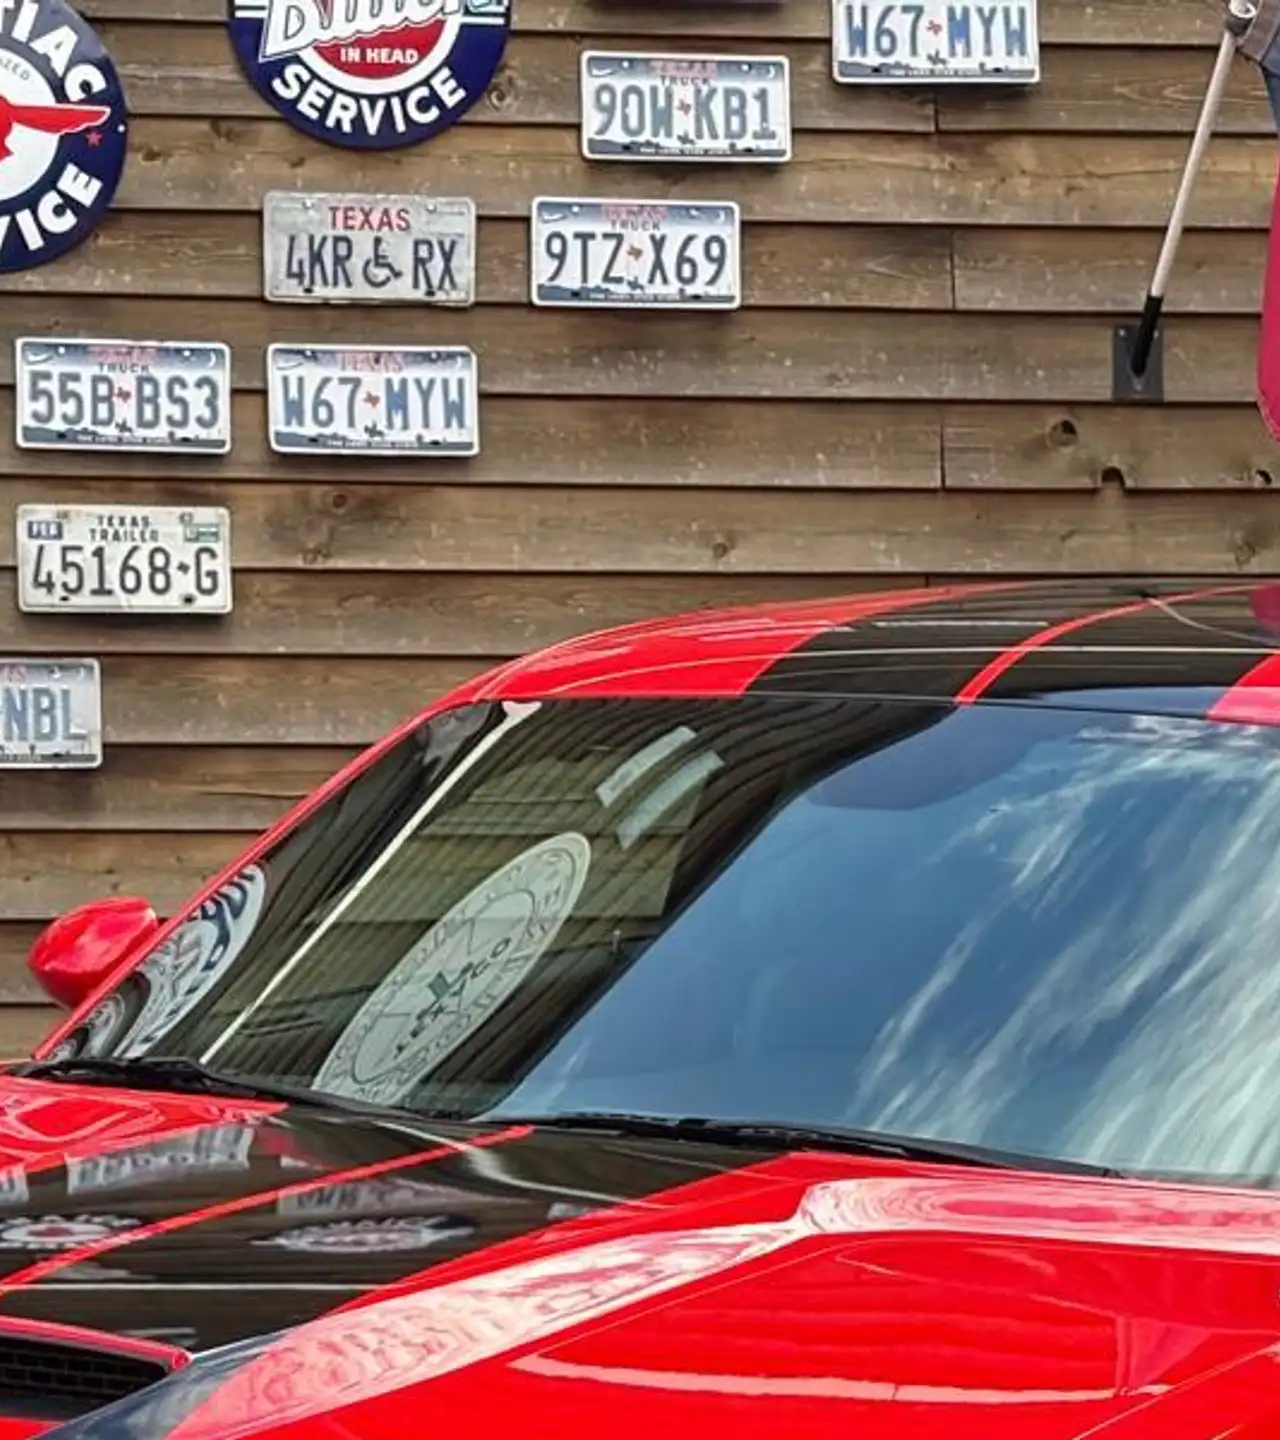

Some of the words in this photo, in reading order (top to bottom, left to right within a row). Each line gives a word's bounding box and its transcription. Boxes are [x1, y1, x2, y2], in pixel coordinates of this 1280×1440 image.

[340, 48, 361, 63] IN
[367, 48, 419, 65] HEAD
[847, 4, 924, 57] W67
[947, 5, 1026, 58] MYW
[271, 63, 467, 136] SERVICE
[694, 86, 777, 141] KB1
[329, 206, 411, 232] TEXAS
[611, 220, 661, 231] TRUCK
[286, 234, 353, 288] 4KR
[413, 238, 458, 291] RX
[545, 231, 625, 284] 9TZ
[648, 233, 727, 286] X69
[98, 362, 151, 373] TRUCK
[29, 370, 116, 427] 55B
[136, 375, 220, 430] BS3
[282, 375, 362, 428] W67
[385, 377, 465, 430] MYW
[97, 515, 150, 527] TEXAS
[32, 544, 171, 596] 45168
[4, 686, 88, 742] NBL
